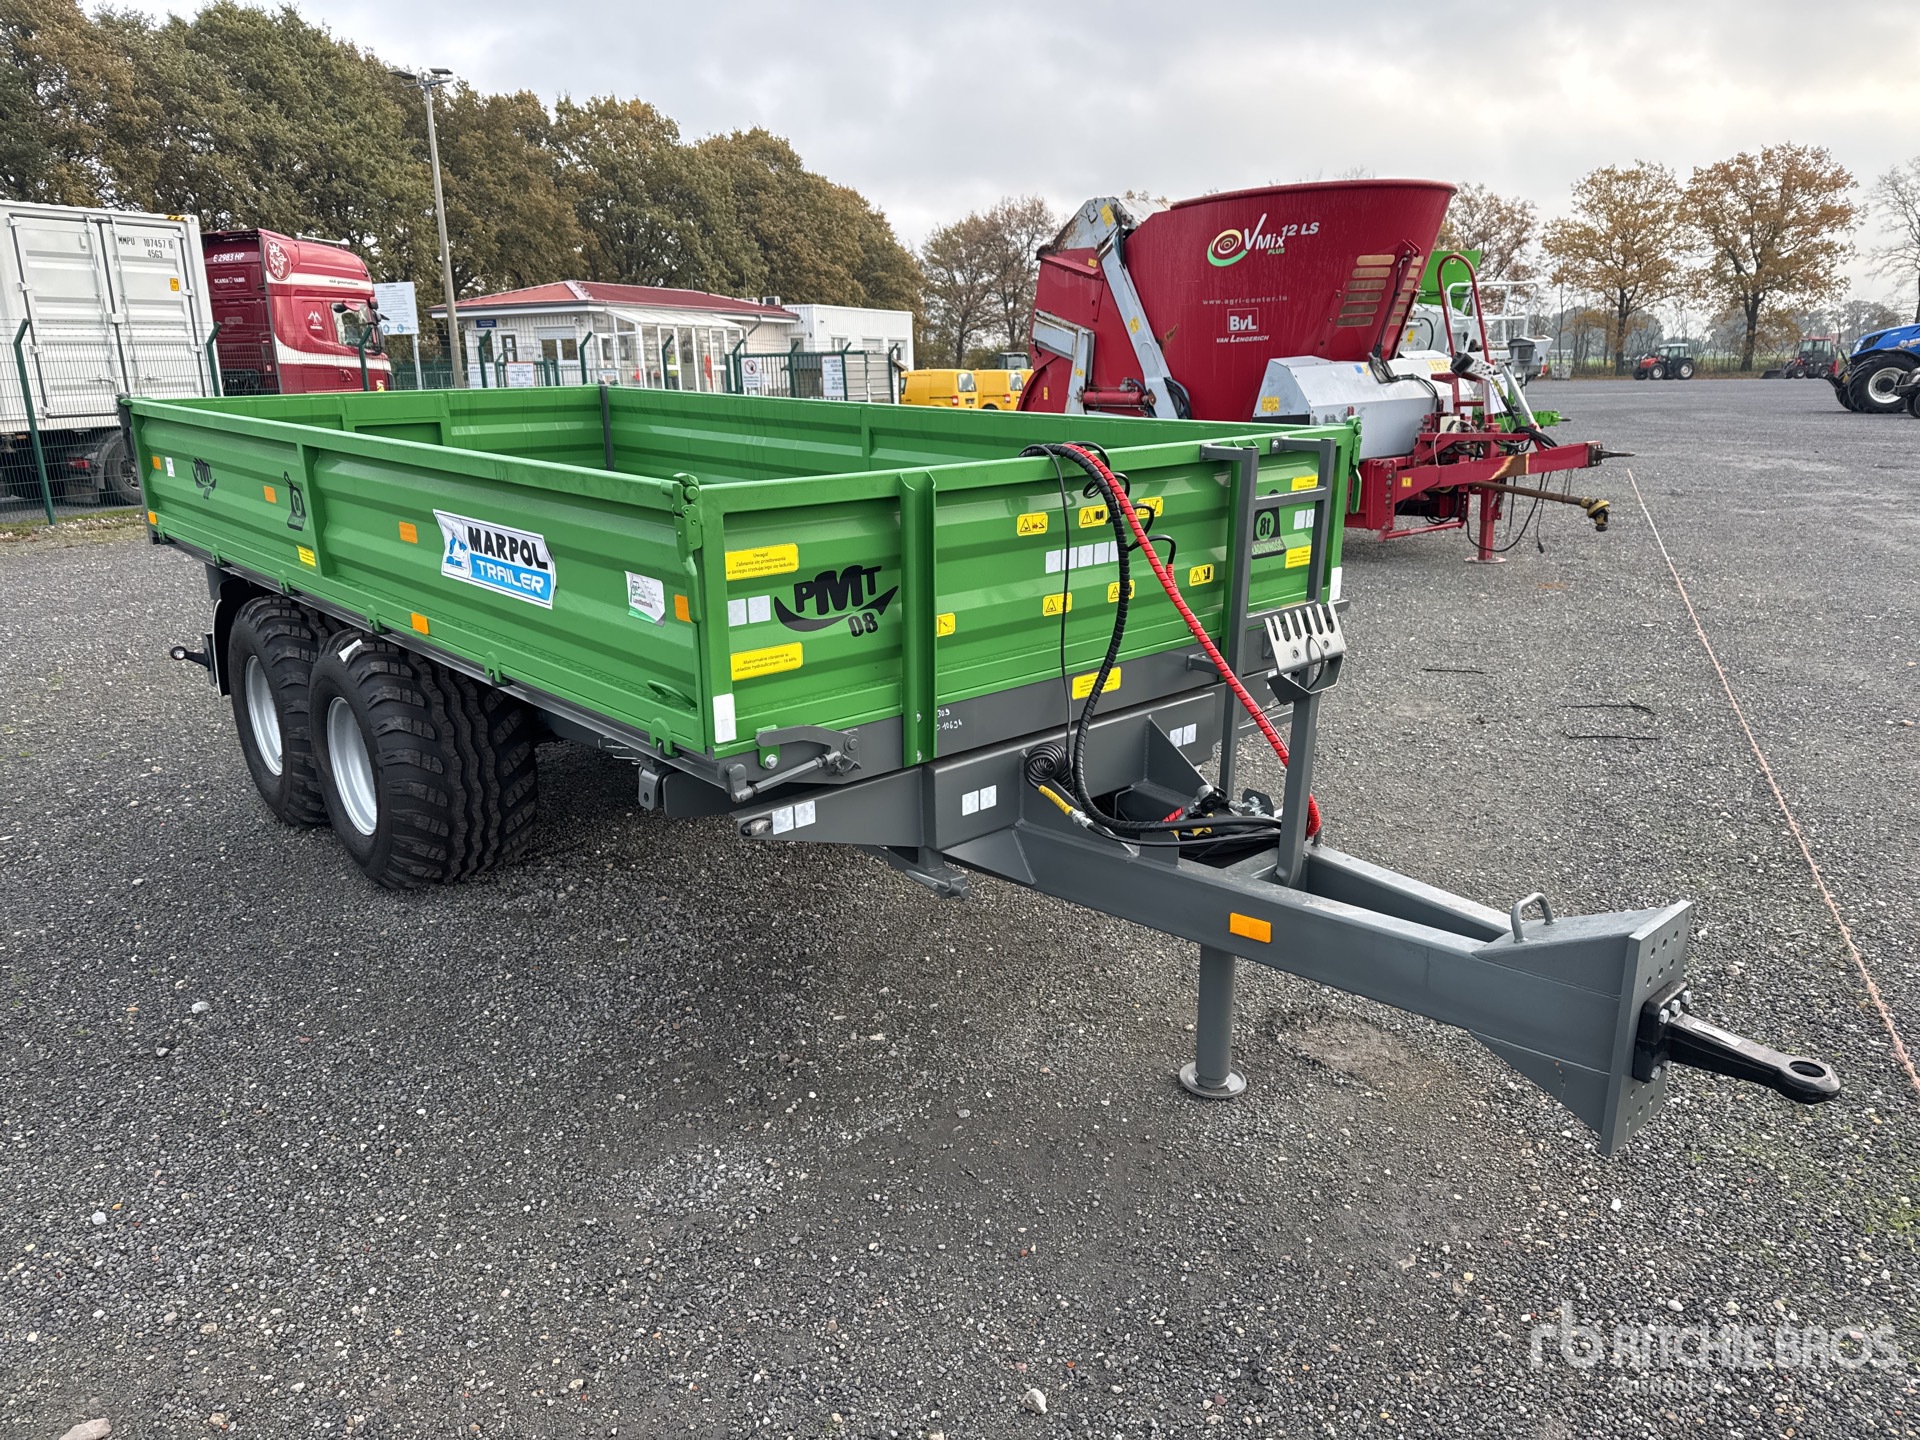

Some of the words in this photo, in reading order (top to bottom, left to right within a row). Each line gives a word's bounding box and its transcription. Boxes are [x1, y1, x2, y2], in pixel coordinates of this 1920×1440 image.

[1281, 224, 1298, 237] 12
[1301, 222, 1320, 235] LS
[118, 237, 136, 246] MMPU
[143, 238, 166, 249] 107457
[1267, 247, 1285, 255] PLUS
[213, 254, 218, 262] E
[218, 253, 234, 262] 2983
[234, 252, 245, 261] HP
[1202, 294, 1288, 306] www.agri-center.lu
[1229, 315, 1257, 331] BvL
[1259, 516, 1271, 537] 8t
[467, 525, 549, 571] MARPOL
[476, 559, 545, 594] TRAILER
[793, 565, 883, 616] PMT
[848, 612, 879, 638] 08
